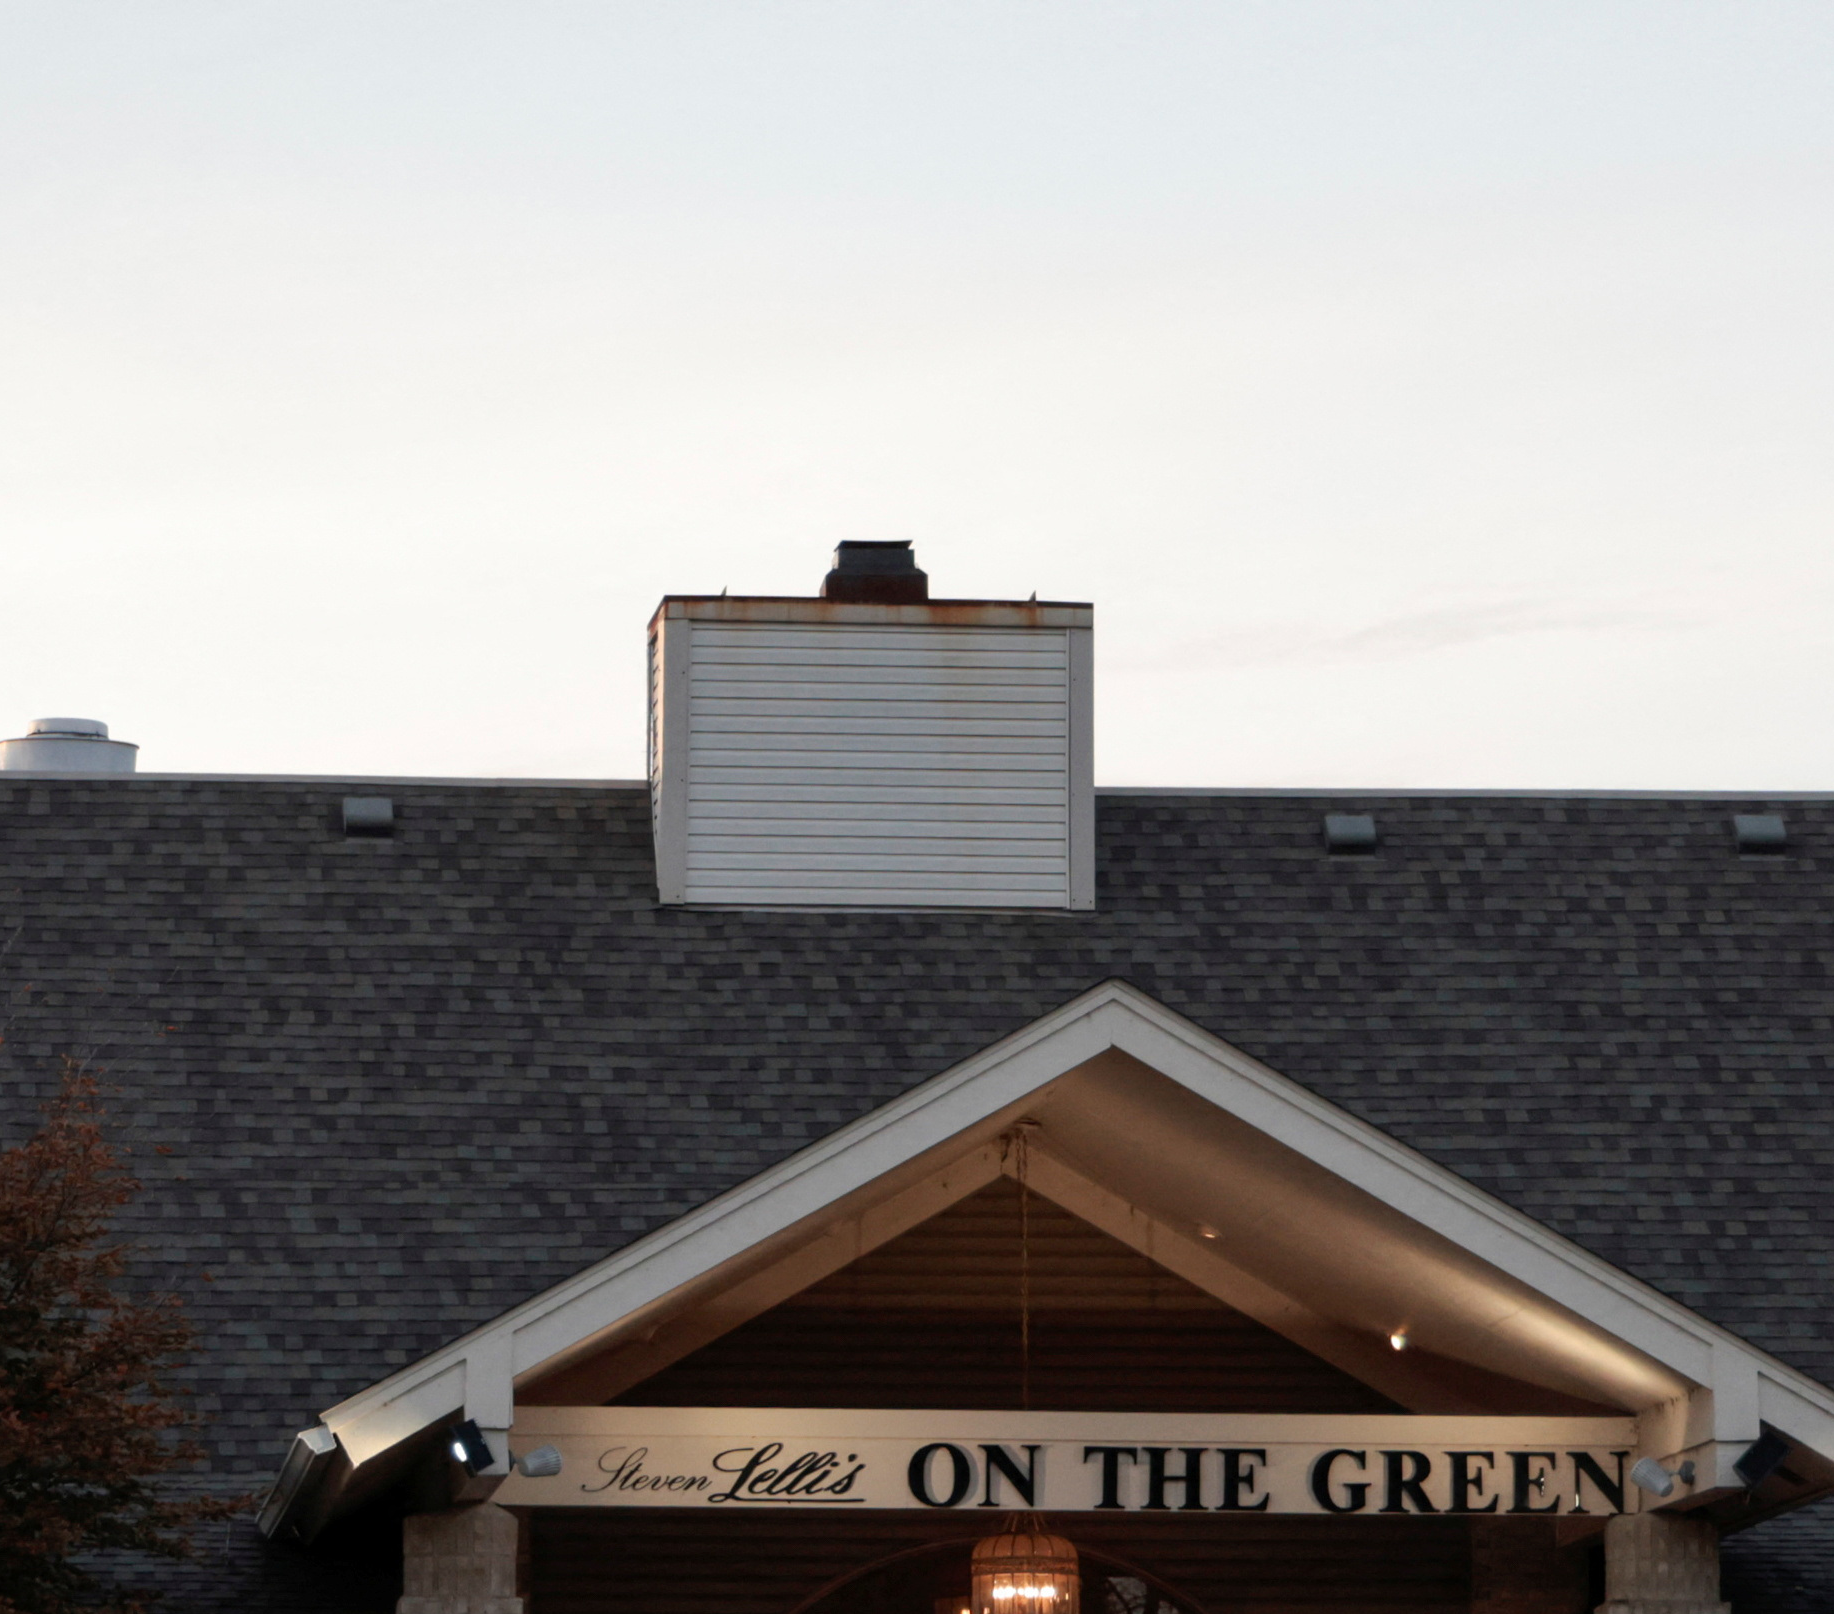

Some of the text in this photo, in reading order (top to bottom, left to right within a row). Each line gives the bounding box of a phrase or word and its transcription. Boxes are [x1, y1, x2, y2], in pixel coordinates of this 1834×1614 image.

[581, 1442, 1630, 1516] Steven Lelli's ON THE GREEN
